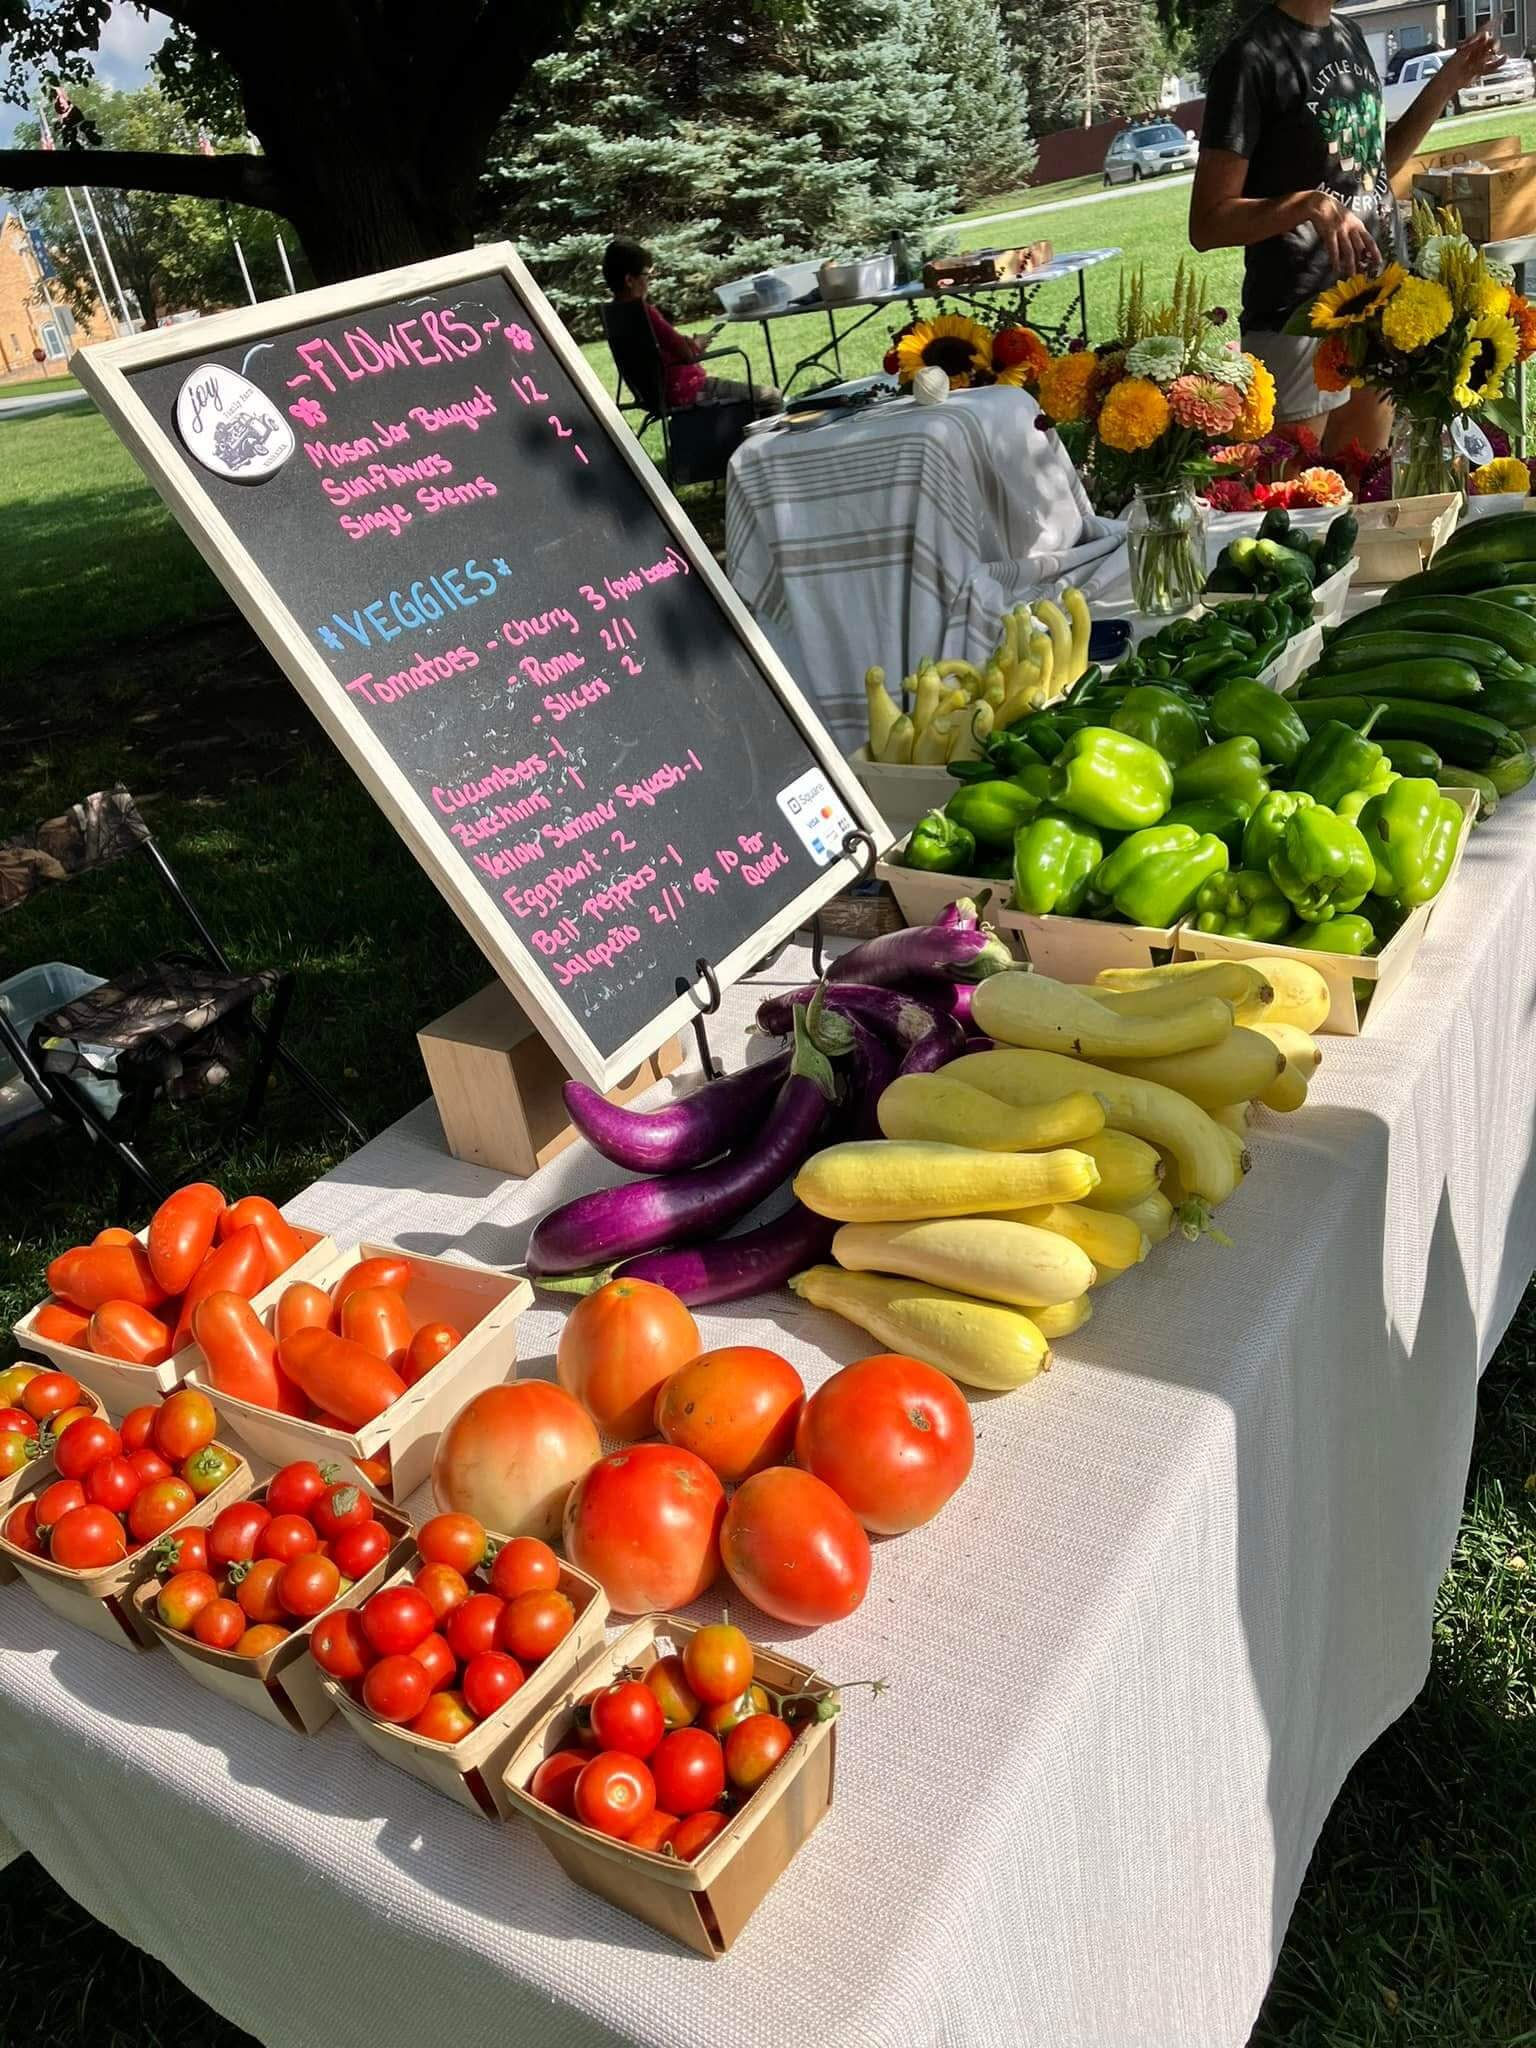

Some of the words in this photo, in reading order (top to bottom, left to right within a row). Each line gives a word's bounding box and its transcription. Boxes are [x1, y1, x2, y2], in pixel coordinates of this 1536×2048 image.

[1306, 101, 1319, 115] A
[1312, 60, 1351, 95] LITTLE
[303, 437, 380, 469] Mason
[371, 420, 411, 448] Jar
[510, 376, 549, 404] 12
[321, 453, 453, 506] Sunflowers
[548, 415, 574, 438] 2
[416, 475, 498, 513] Stems
[574, 443, 590, 465] 1
[344, 646, 480, 705] Tomatoes
[502, 607, 580, 646] Cherry
[578, 584, 607, 611] 3
[518, 651, 586, 688] Roma
[599, 617, 638, 651] 2/1
[542, 676, 611, 722] Slicers
[620, 654, 644, 677] 2
[431, 753, 549, 815] Cucumbers
[798, 783, 825, 806] Square
[473, 842, 545, 880] Yellow
[541, 798, 617, 849] Summer
[739, 841, 791, 887] Quart
[501, 848, 603, 920] Eggplant
[610, 829, 638, 853] 2
[530, 916, 581, 956] Bell
[552, 924, 642, 987] Jalapeño
[647, 885, 686, 925] 2/1
[714, 848, 740, 875] 10
